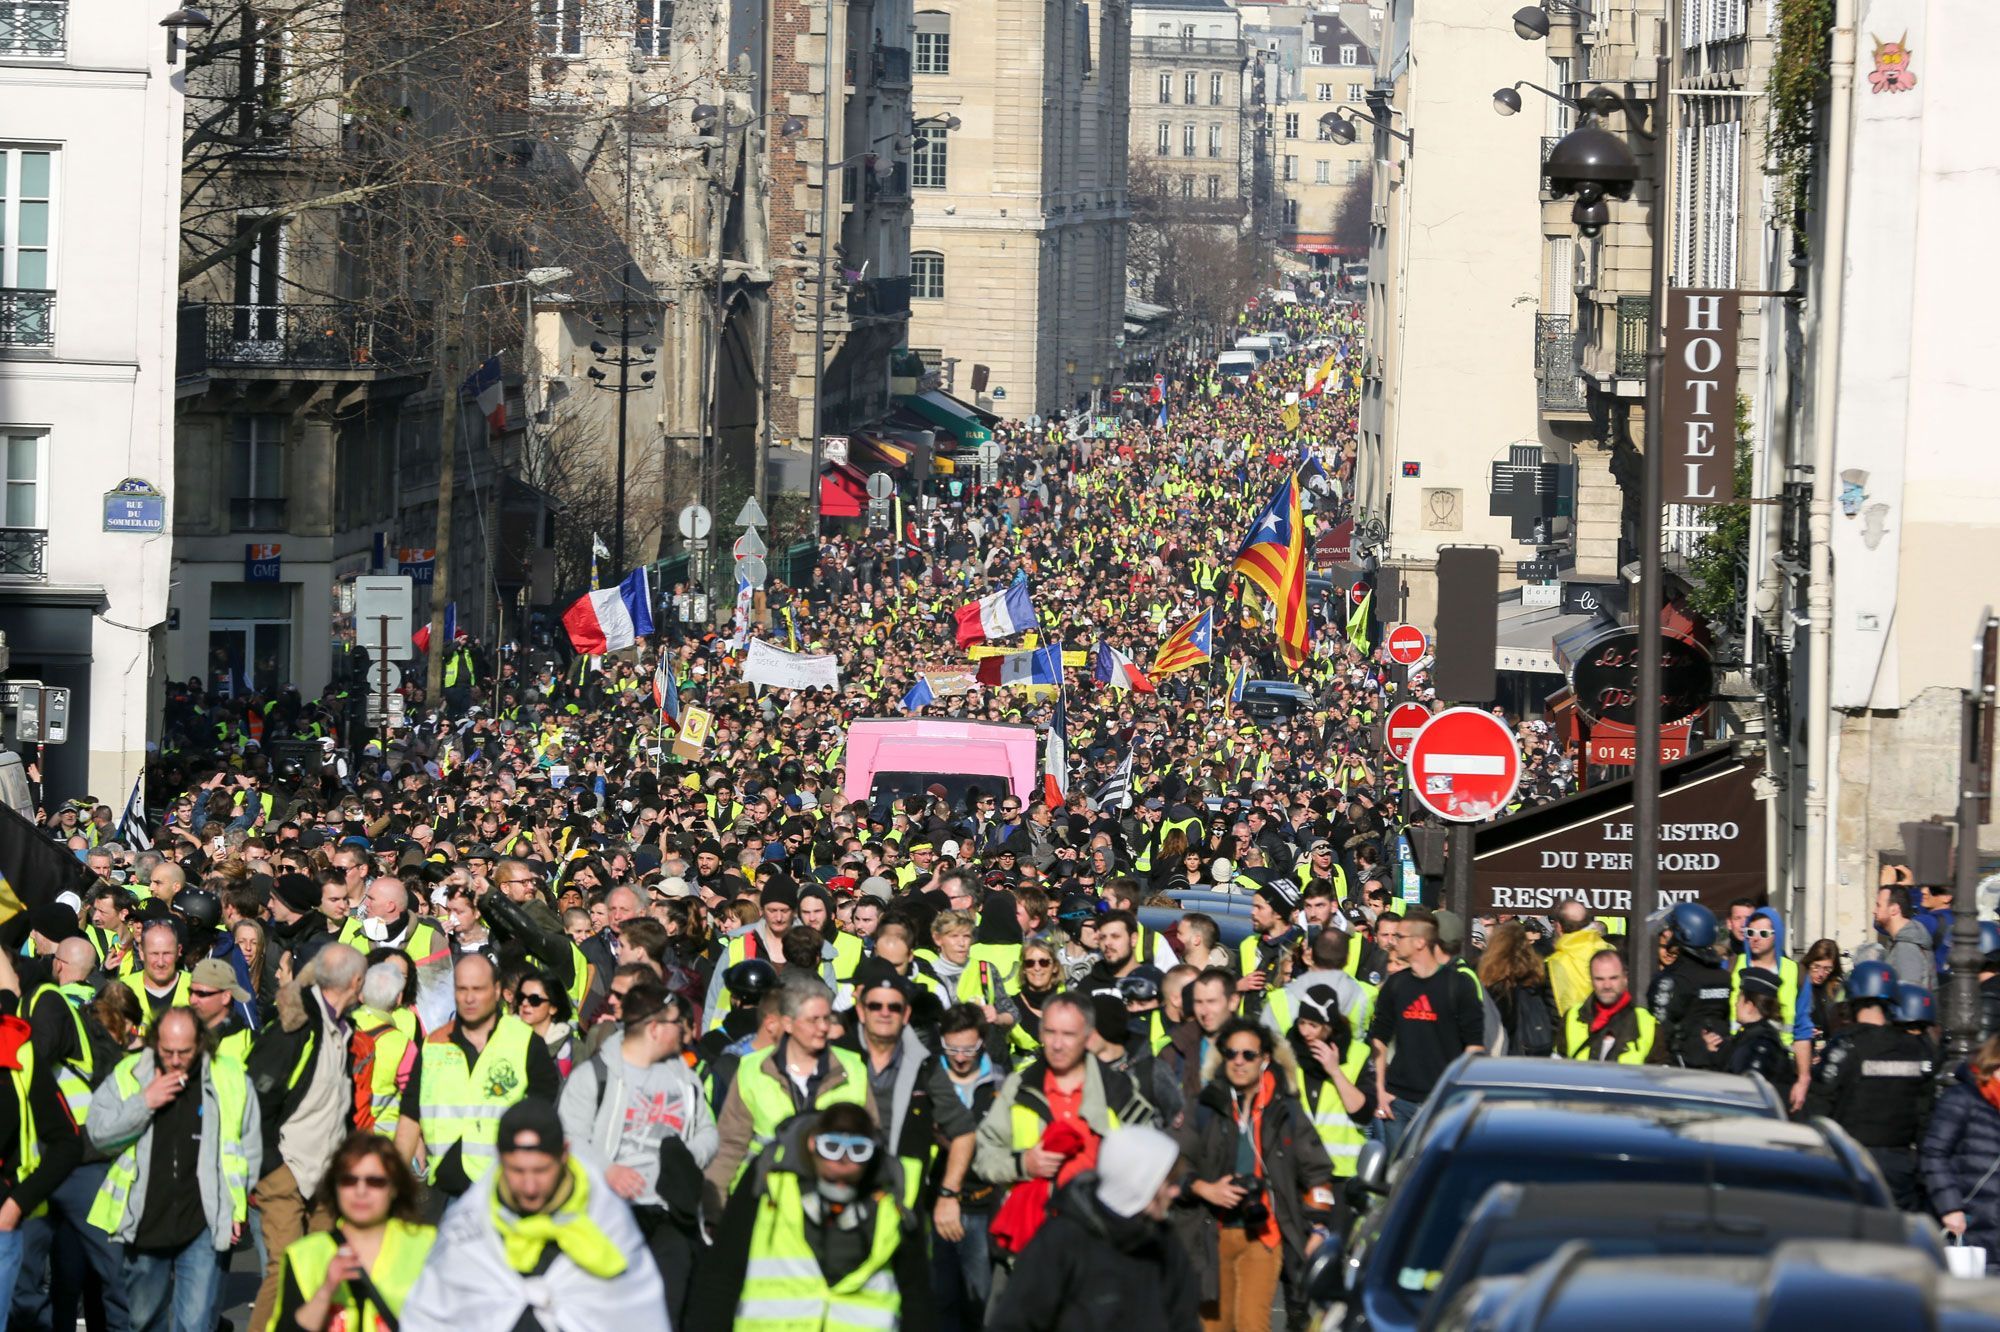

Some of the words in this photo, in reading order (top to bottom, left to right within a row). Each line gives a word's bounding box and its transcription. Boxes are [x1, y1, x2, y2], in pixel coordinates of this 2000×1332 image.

[1683, 295, 1724, 498] HOTEL
[965, 431, 984, 439] BAR
[127, 510, 141, 518] DU
[107, 518, 161, 527] SOMMERARD
[253, 564, 279, 577] GMF
[401, 567, 433, 580] GMF
[1573, 590, 1599, 610] le
[1598, 746, 1615, 759] 01
[1620, 747, 1636, 759] 43
[1662, 748, 1680, 760] 32
[1602, 823, 1633, 840] LE
[1657, 821, 1739, 841] ISTRO
[1540, 851, 1579, 869] DU
[1584, 852, 1720, 871] PERORD
[1491, 886, 1699, 911] RESTAURNT
